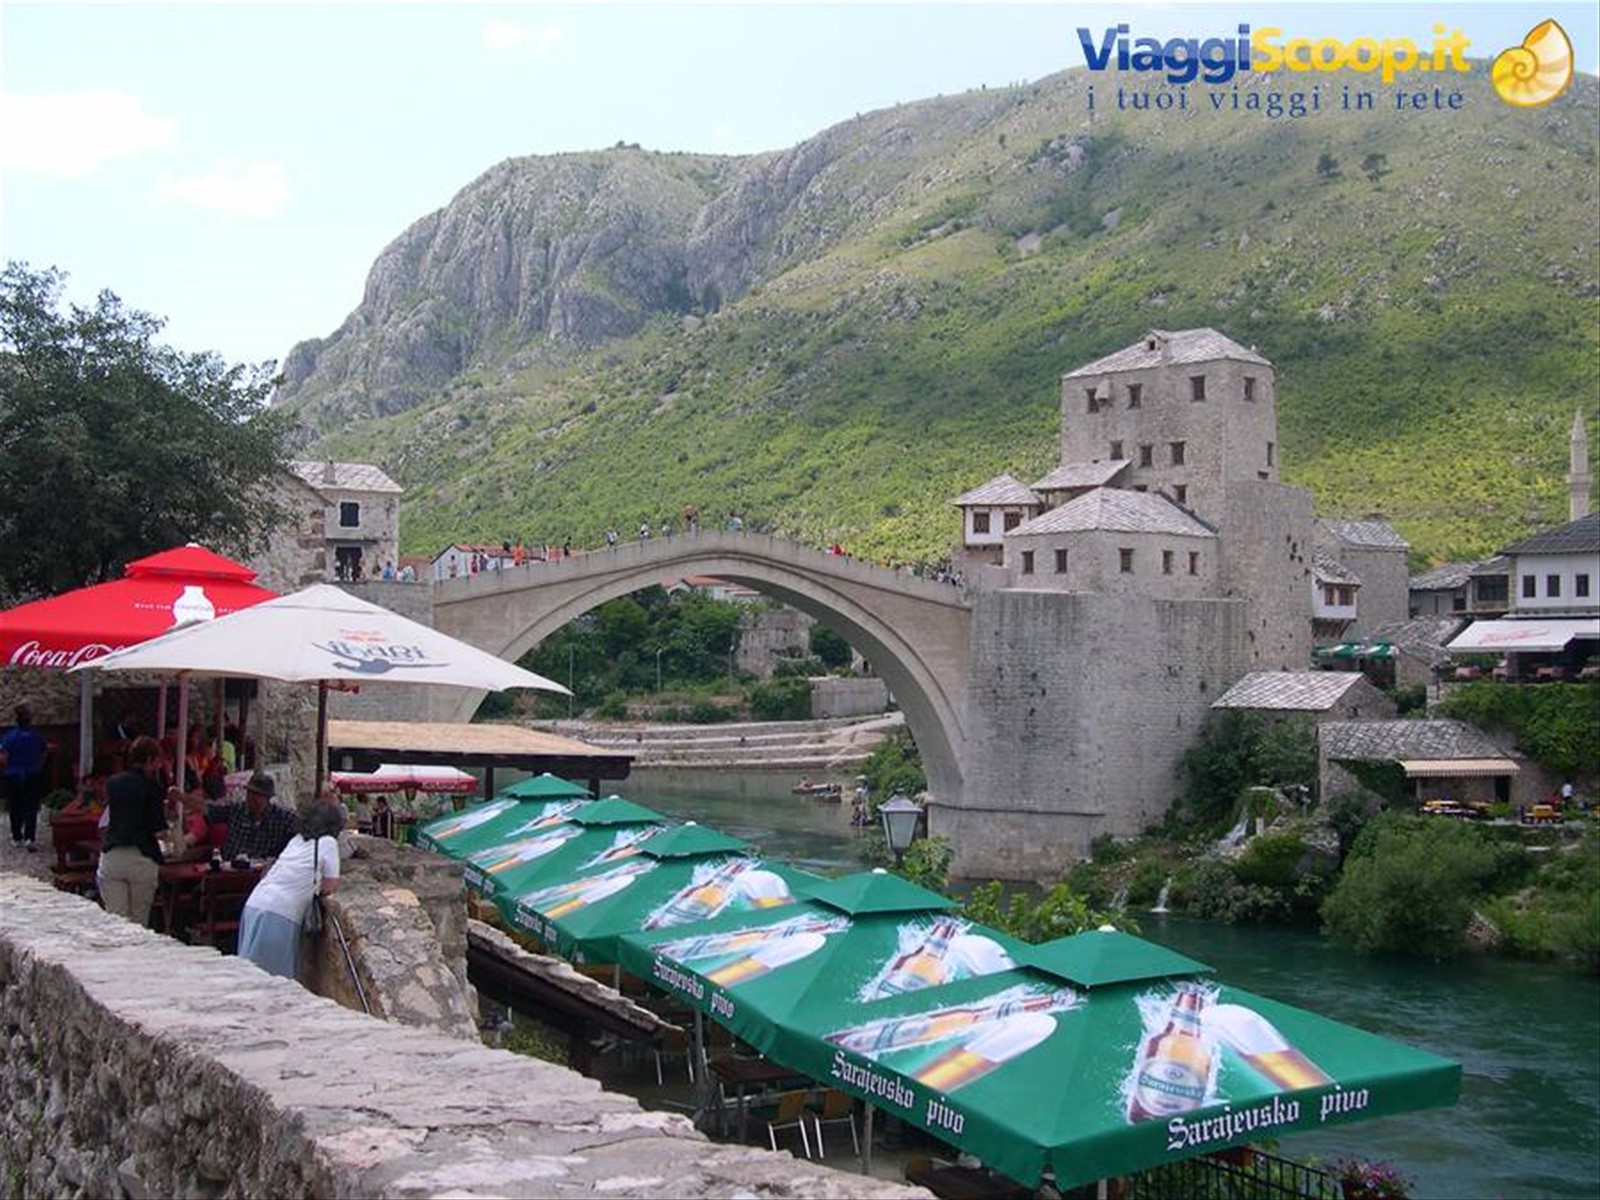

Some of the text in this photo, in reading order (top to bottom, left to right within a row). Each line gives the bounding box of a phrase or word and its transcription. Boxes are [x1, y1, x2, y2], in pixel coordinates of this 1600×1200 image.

[831, 1050, 965, 1134] Sarajevsko pivo
[1167, 1084, 1369, 1150] Sarajevsko pivo
